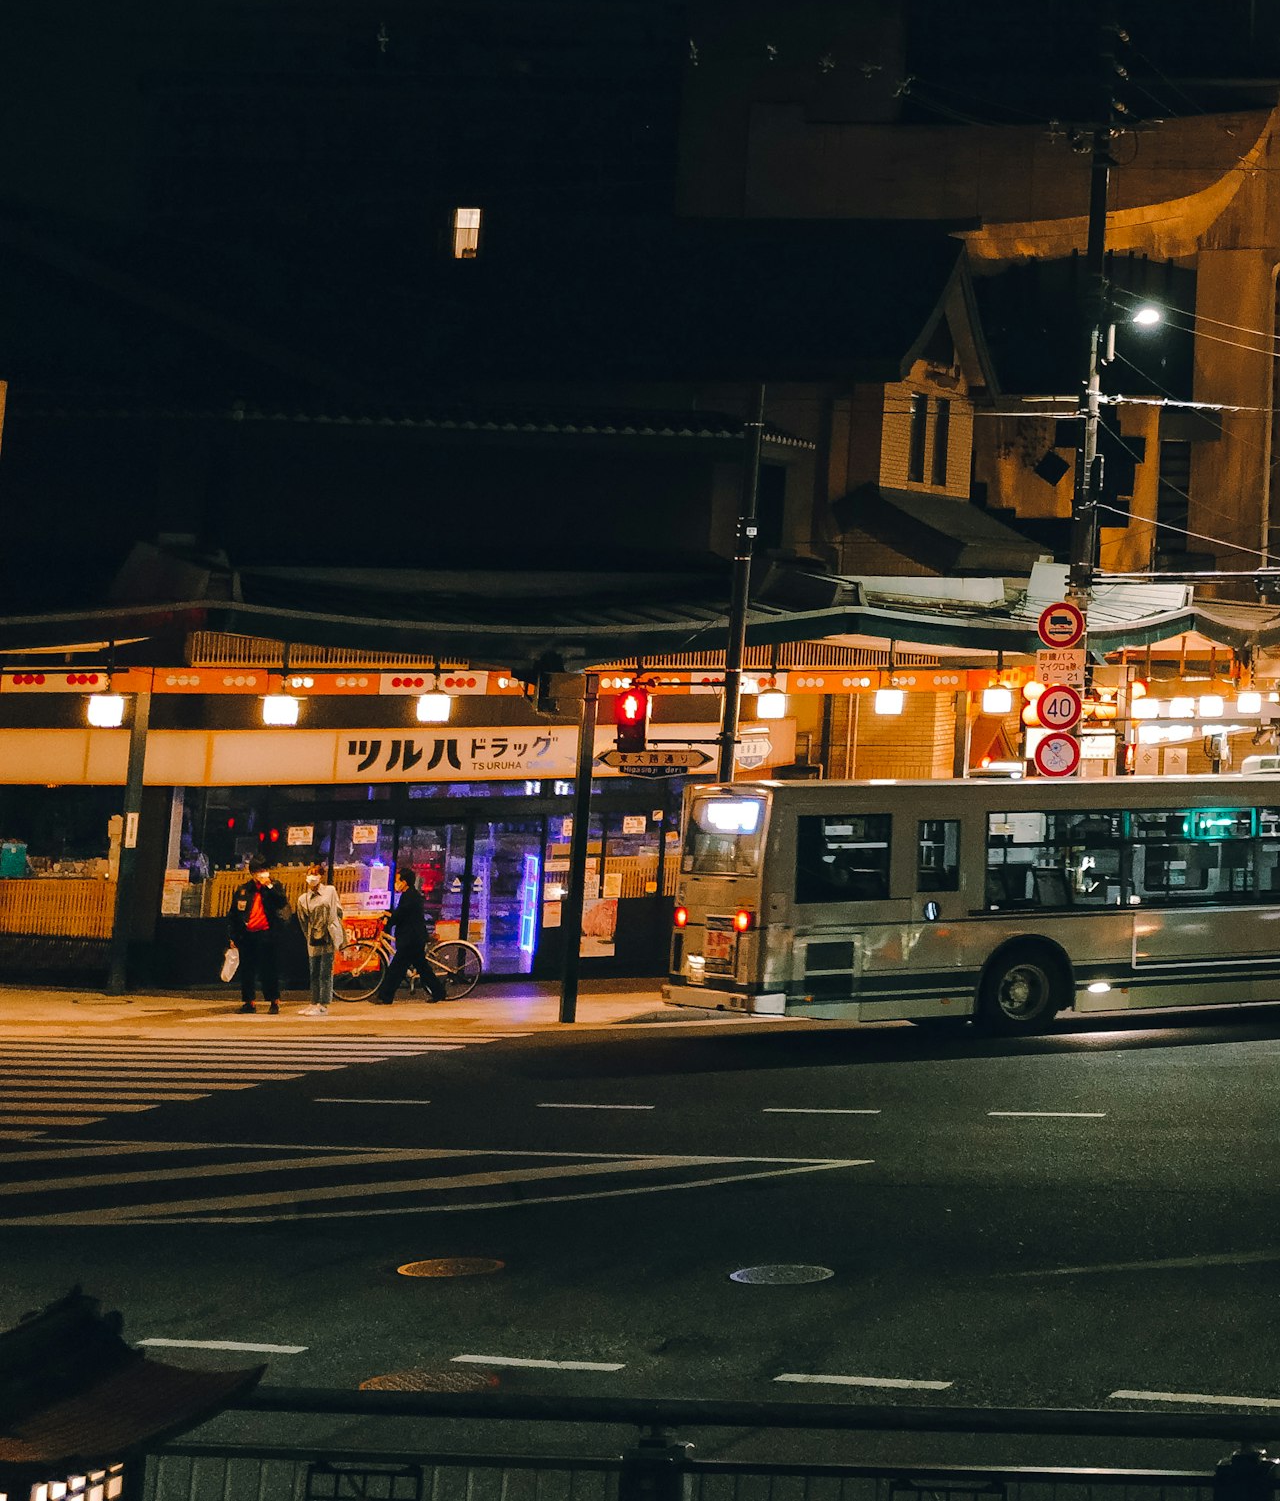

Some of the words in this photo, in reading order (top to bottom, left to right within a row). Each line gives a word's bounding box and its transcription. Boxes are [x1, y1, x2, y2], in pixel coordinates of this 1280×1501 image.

[1047, 698, 1071, 717] 40
[619, 753, 689, 764] 東大路通り
[472, 762, 522, 770] TSURUHA
